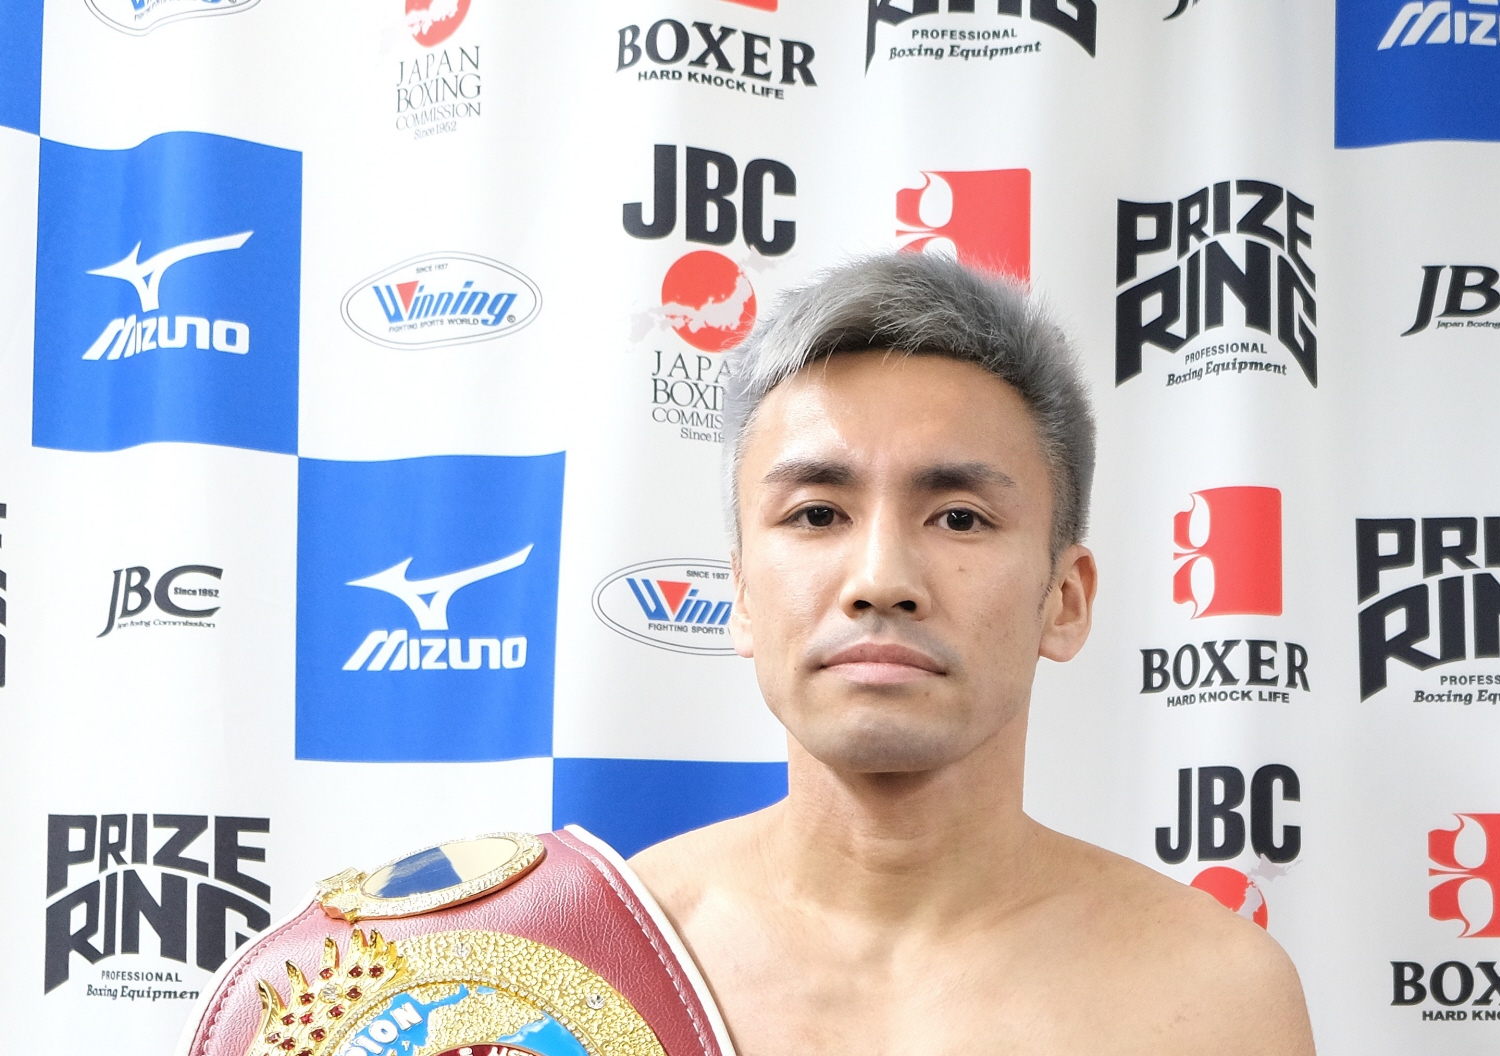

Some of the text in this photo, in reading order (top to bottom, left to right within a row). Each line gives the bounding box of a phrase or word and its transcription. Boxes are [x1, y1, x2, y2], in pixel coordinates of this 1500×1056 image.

[911, 28, 1018, 41] PROFESSIONAL
[616, 18, 818, 87] BOXER
[888, 40, 1042, 61] Boxing Equipment
[398, 46, 481, 87] JAPAN
[397, 73, 482, 114] BOXING
[638, 69, 785, 100] HARD KNOCK LIFE
[396, 102, 481, 132] COMMISSION
[414, 120, 457, 141] Since 1952
[622, 143, 797, 257] JBC
[1116, 179, 1317, 293] PRIZE
[372, 280, 518, 327] Winning
[1115, 239, 1318, 389] RING
[82, 316, 250, 361] MIZUNO
[389, 317, 479, 334] FIGHTING SPORTS WORLD
[1437, 320, 1464, 329] Japan
[1184, 342, 1268, 365] PROFESSIONAL
[1166, 358, 1287, 387] Boxing Equipment
[680, 427, 712, 442] Since
[686, 570, 709, 578] SINCE
[96, 564, 224, 638] JBC
[625, 578, 733, 625] Winn
[648, 623, 688, 633] FIGHTING
[691, 626, 725, 635] SPORTS
[341, 629, 527, 672] MIZUNO
[1140, 639, 1311, 694] BOXER
[1166, 689, 1290, 708] HARD KNOCK LIFE
[1413, 690, 1473, 704] Boxing
[1155, 763, 1301, 864] JBC
[46, 813, 271, 905] PRIZE
[44, 869, 271, 996] RING
[101, 970, 183, 982] PROFESSIONAL
[86, 984, 200, 1001] Boxing Equipmen
[1422, 1010, 1468, 1022] HARD
